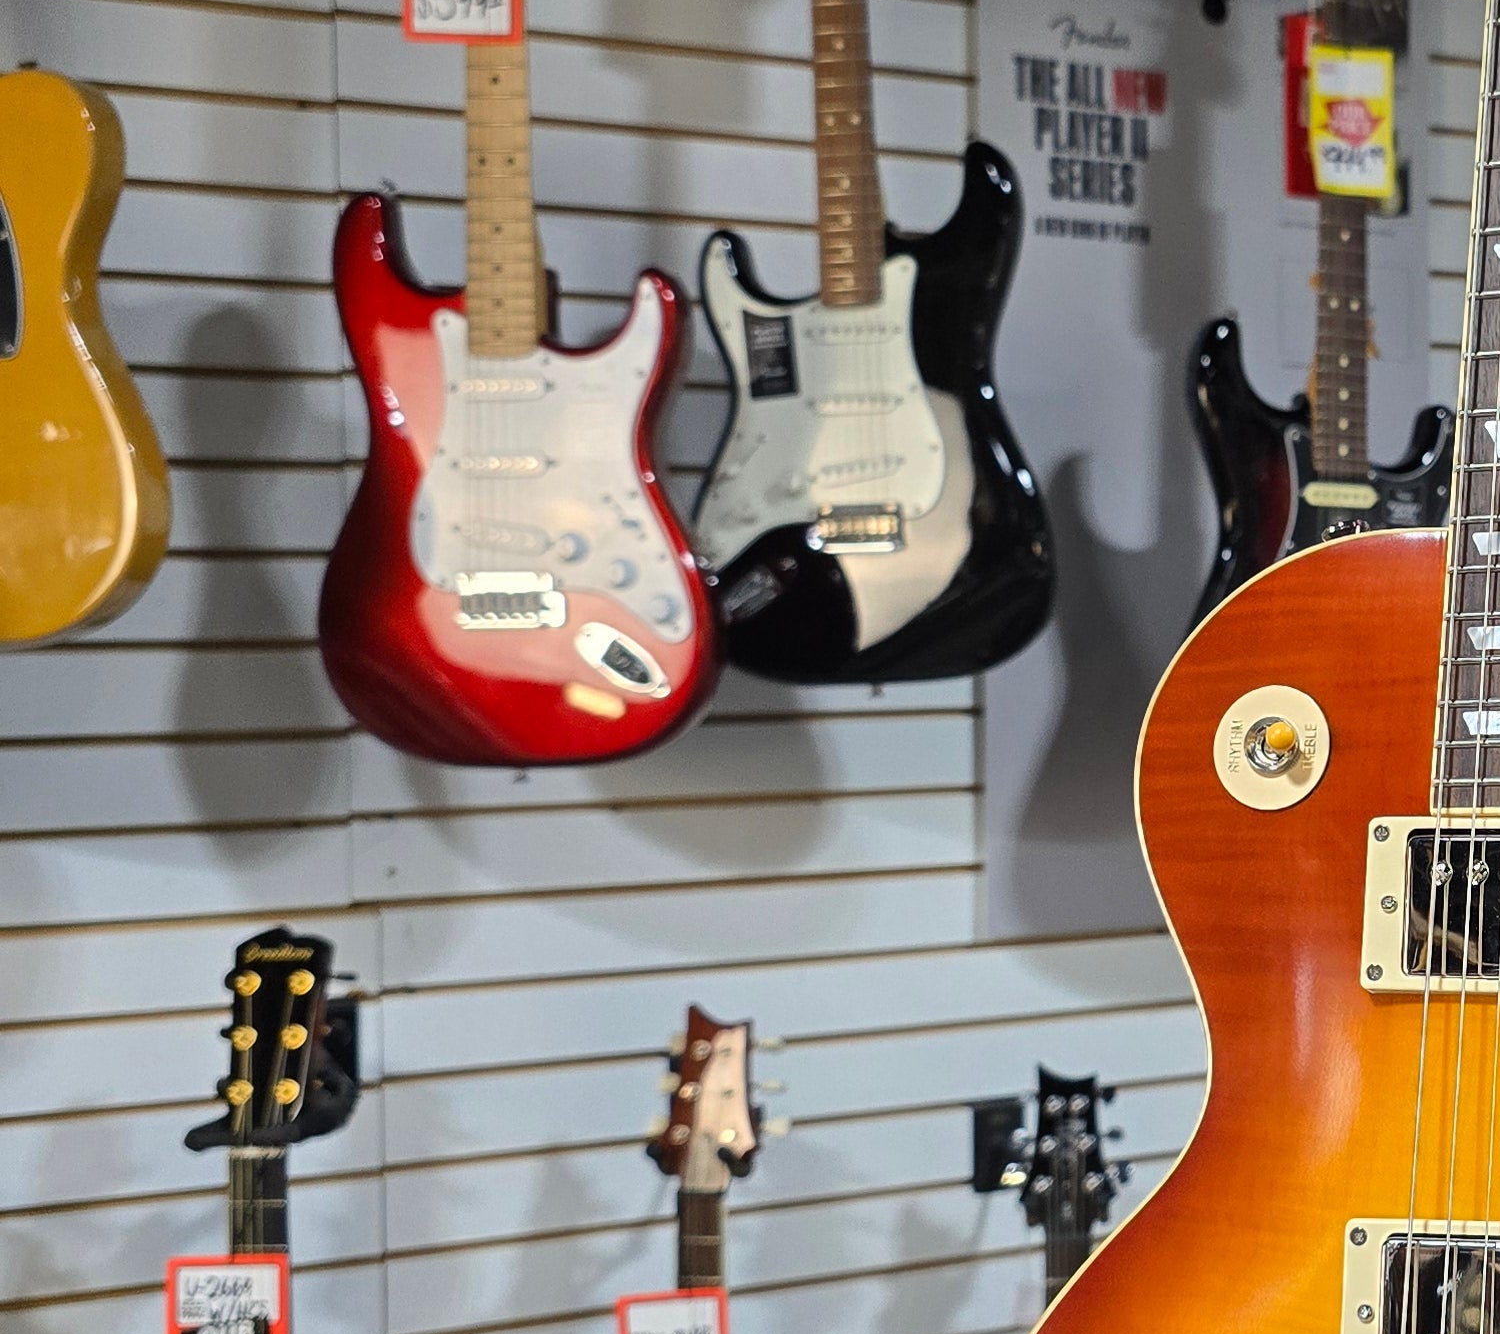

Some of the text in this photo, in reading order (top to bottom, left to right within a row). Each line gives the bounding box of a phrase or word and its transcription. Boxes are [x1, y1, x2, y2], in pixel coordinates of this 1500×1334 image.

[1013, 53, 1057, 105] THE
[1068, 62, 1105, 110] ALL
[1034, 107, 1125, 157] PLAYER
[1049, 155, 1136, 208] SERIES
[1301, 723, 1318, 771] TREBLE
